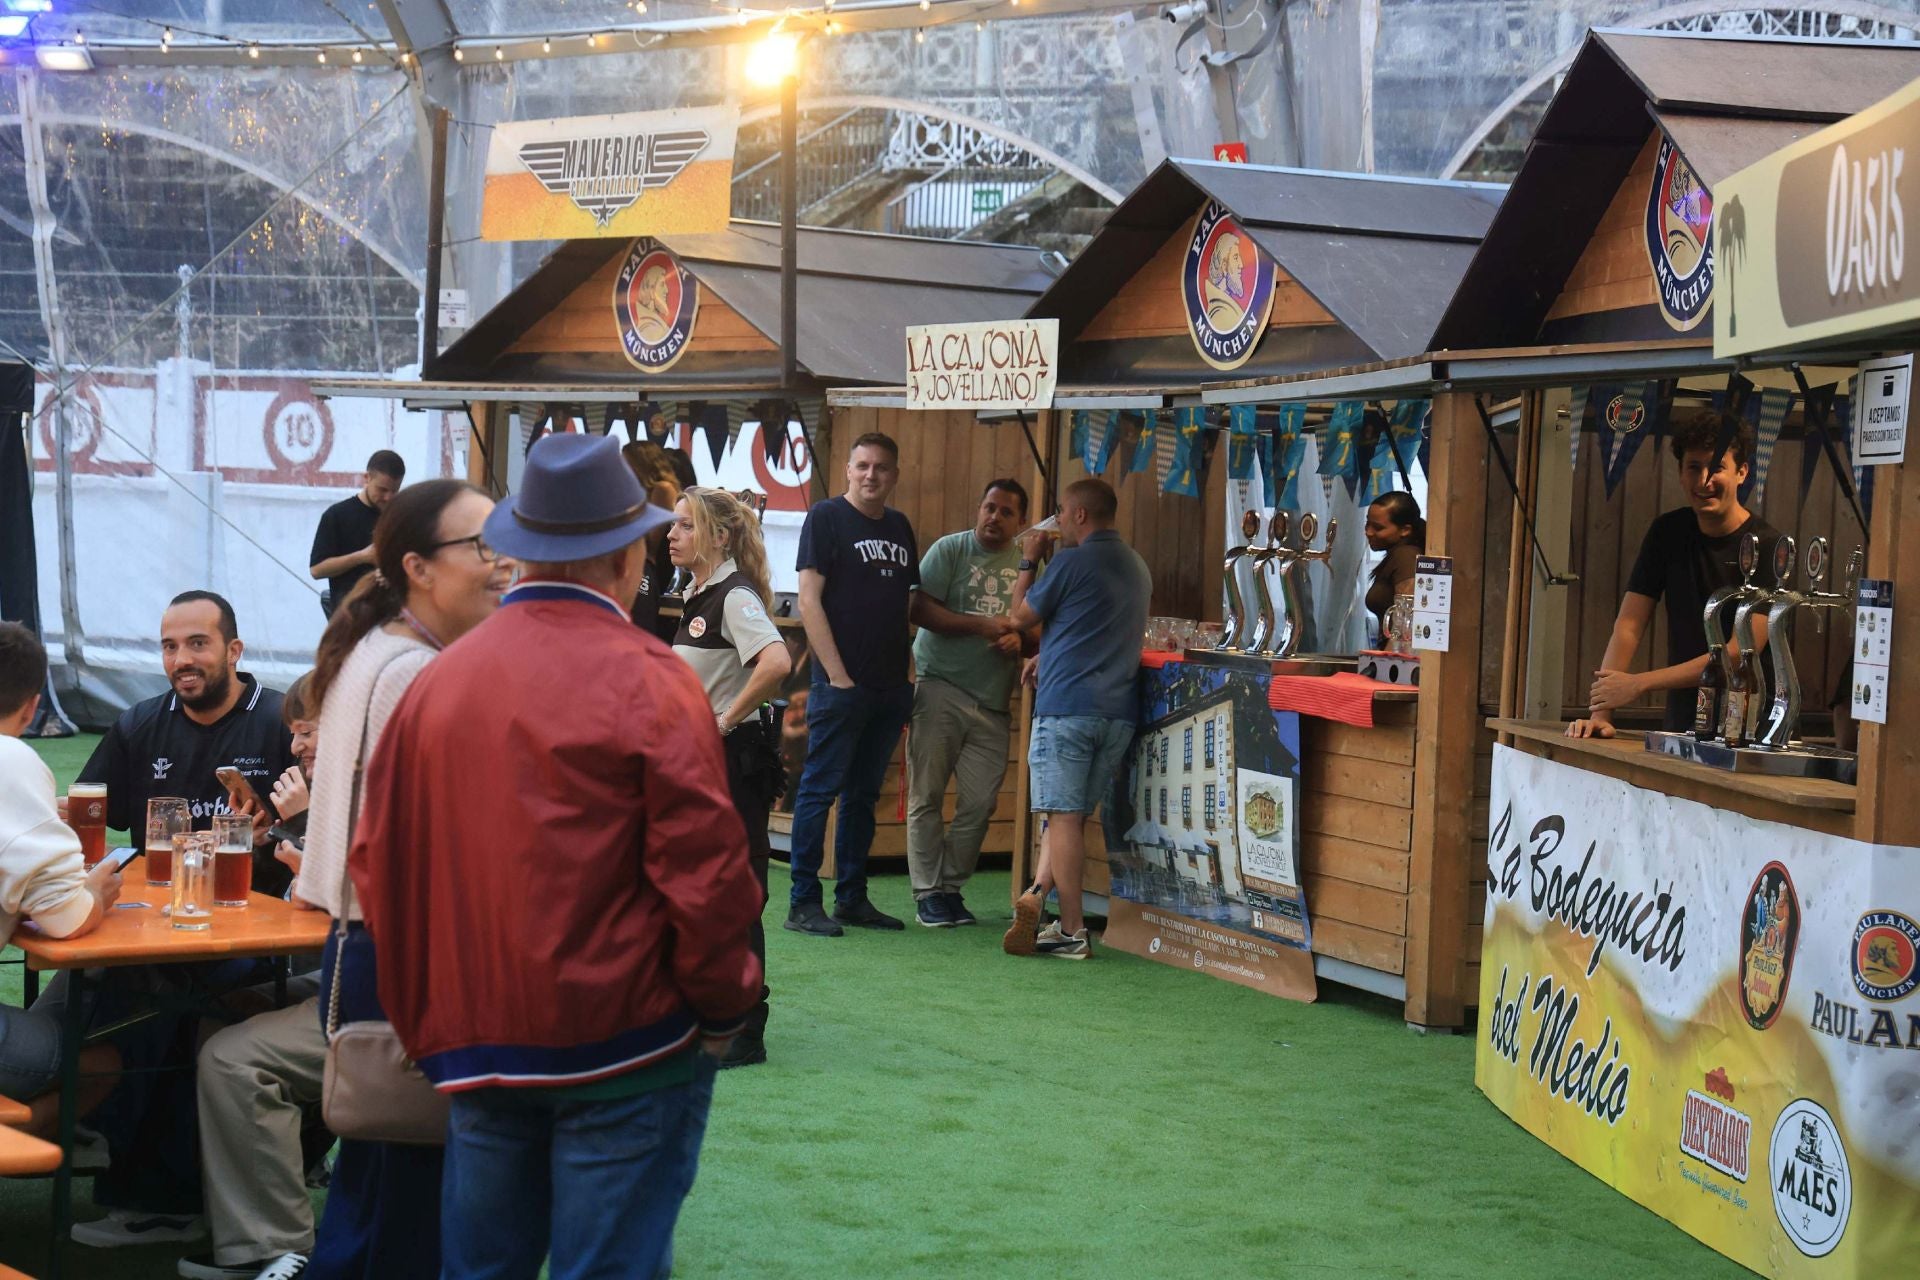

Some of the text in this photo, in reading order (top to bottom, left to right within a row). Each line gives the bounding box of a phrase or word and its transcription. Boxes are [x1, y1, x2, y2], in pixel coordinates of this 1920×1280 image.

[561, 134, 657, 178] MAVERICK
[1826, 144, 1905, 296] OASIS
[624, 327, 684, 363] MÜNCHEN
[907, 329, 1048, 372] LA CASONA
[1195, 311, 1258, 357] MÜNCHEN
[927, 369, 1048, 402] JOVELLANOS
[1868, 405, 1901, 424] ACEPTAMOS
[853, 539, 908, 567] TOKYO
[1417, 561, 1435, 570] PRECIOS
[1859, 589, 1878, 599] PRECIOS
[1217, 715, 1225, 777] HOTEL
[1529, 814, 1686, 977] Bodeguita
[1854, 914, 1920, 949] PAULANER
[1491, 965, 1630, 1125] del Medio
[1682, 1094, 1750, 1177] DESPERADOS
[1778, 1157, 1838, 1219] MAES
